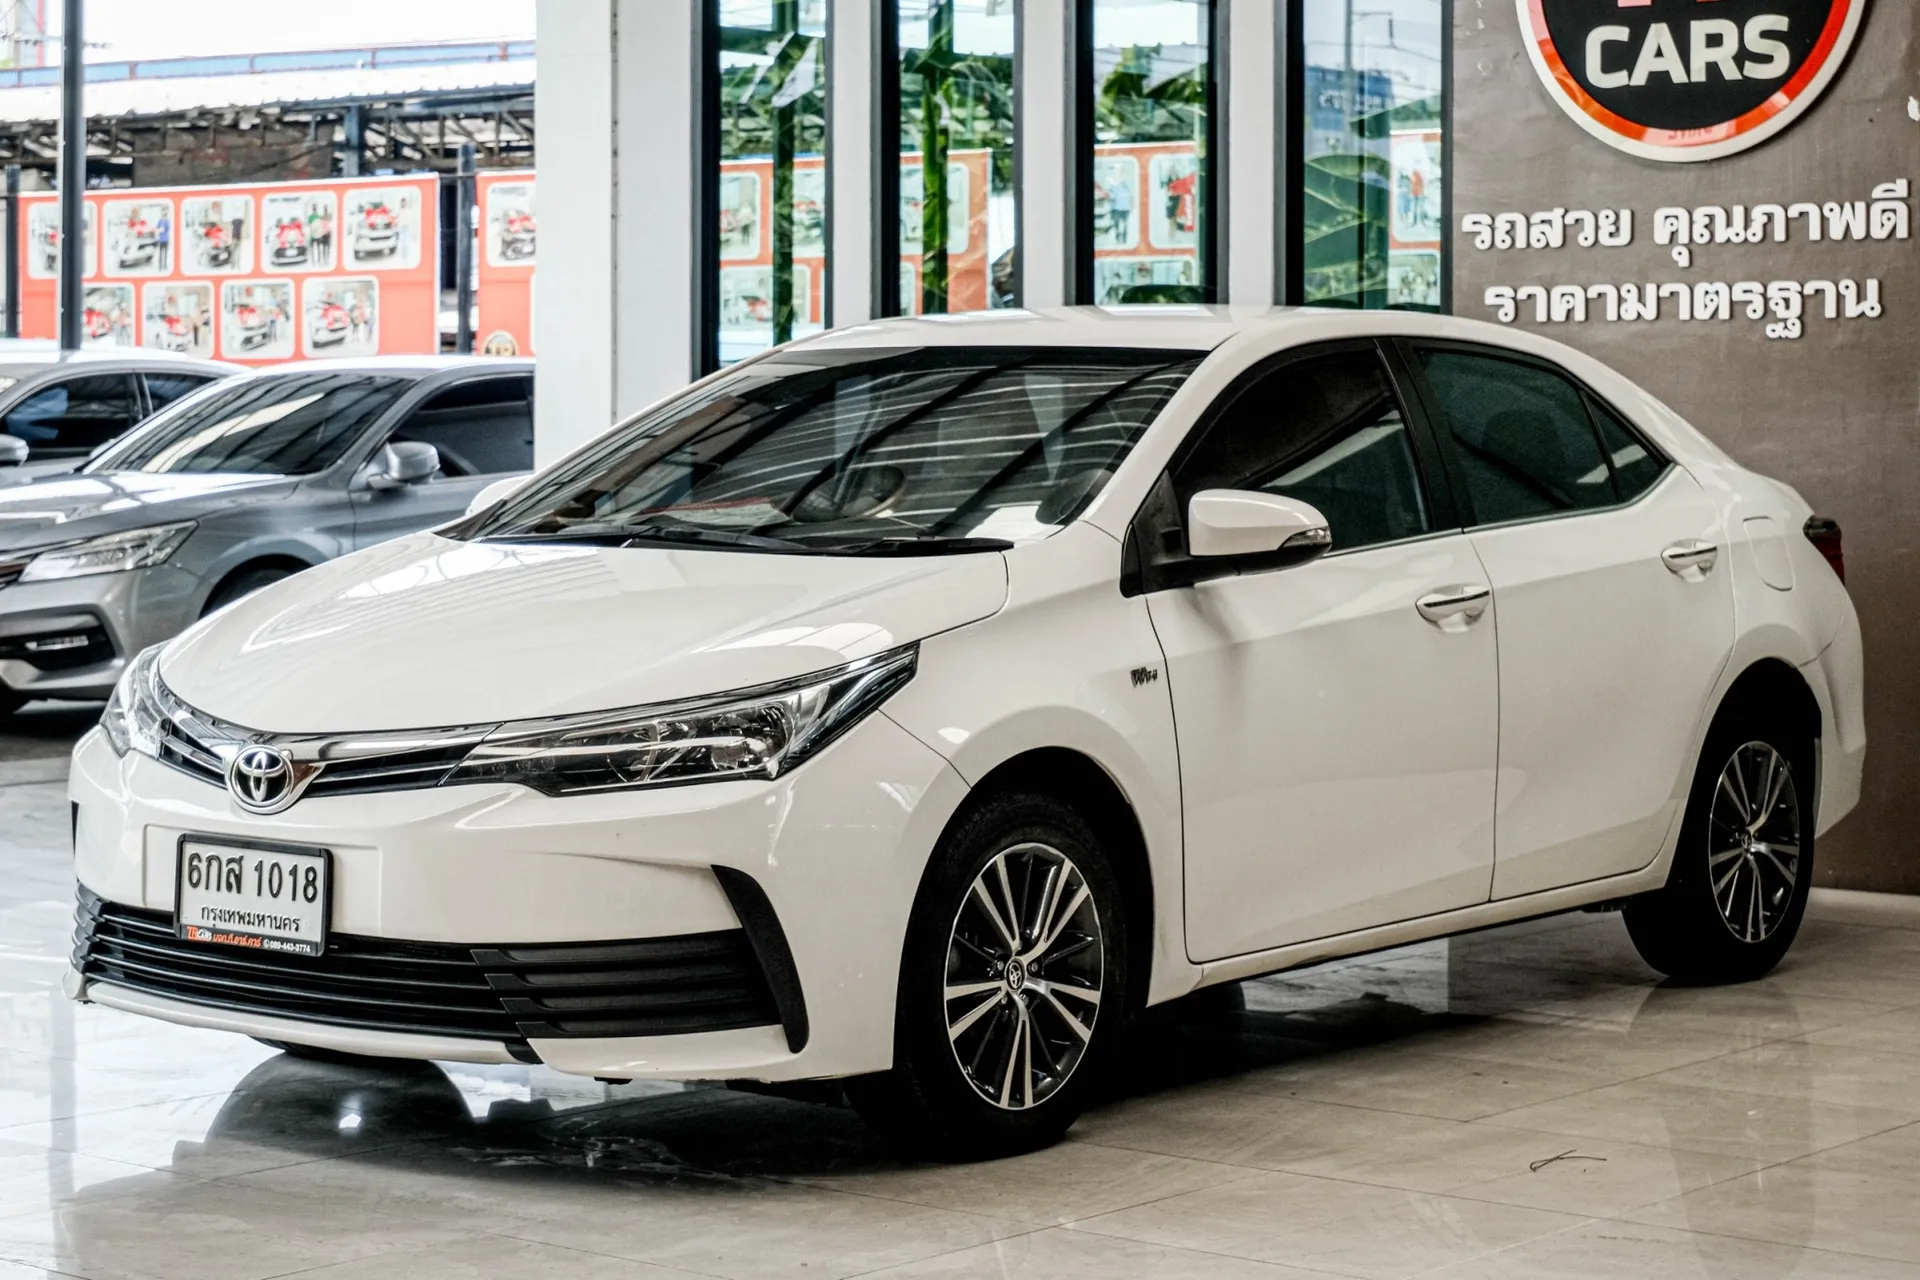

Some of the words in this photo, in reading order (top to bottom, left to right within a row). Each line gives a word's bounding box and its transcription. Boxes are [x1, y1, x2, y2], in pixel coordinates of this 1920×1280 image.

[1585, 14, 1791, 89] CARS
[1461, 207, 1633, 250] รถสวย
[1653, 178, 1910, 268] คุณภาพดี
[1484, 277, 1883, 340] ราคามาตรฐาน
[188, 851, 244, 894] 6กส
[253, 858, 318, 903] 1018
[201, 905, 301, 932] กรุงเทพมหานคร
